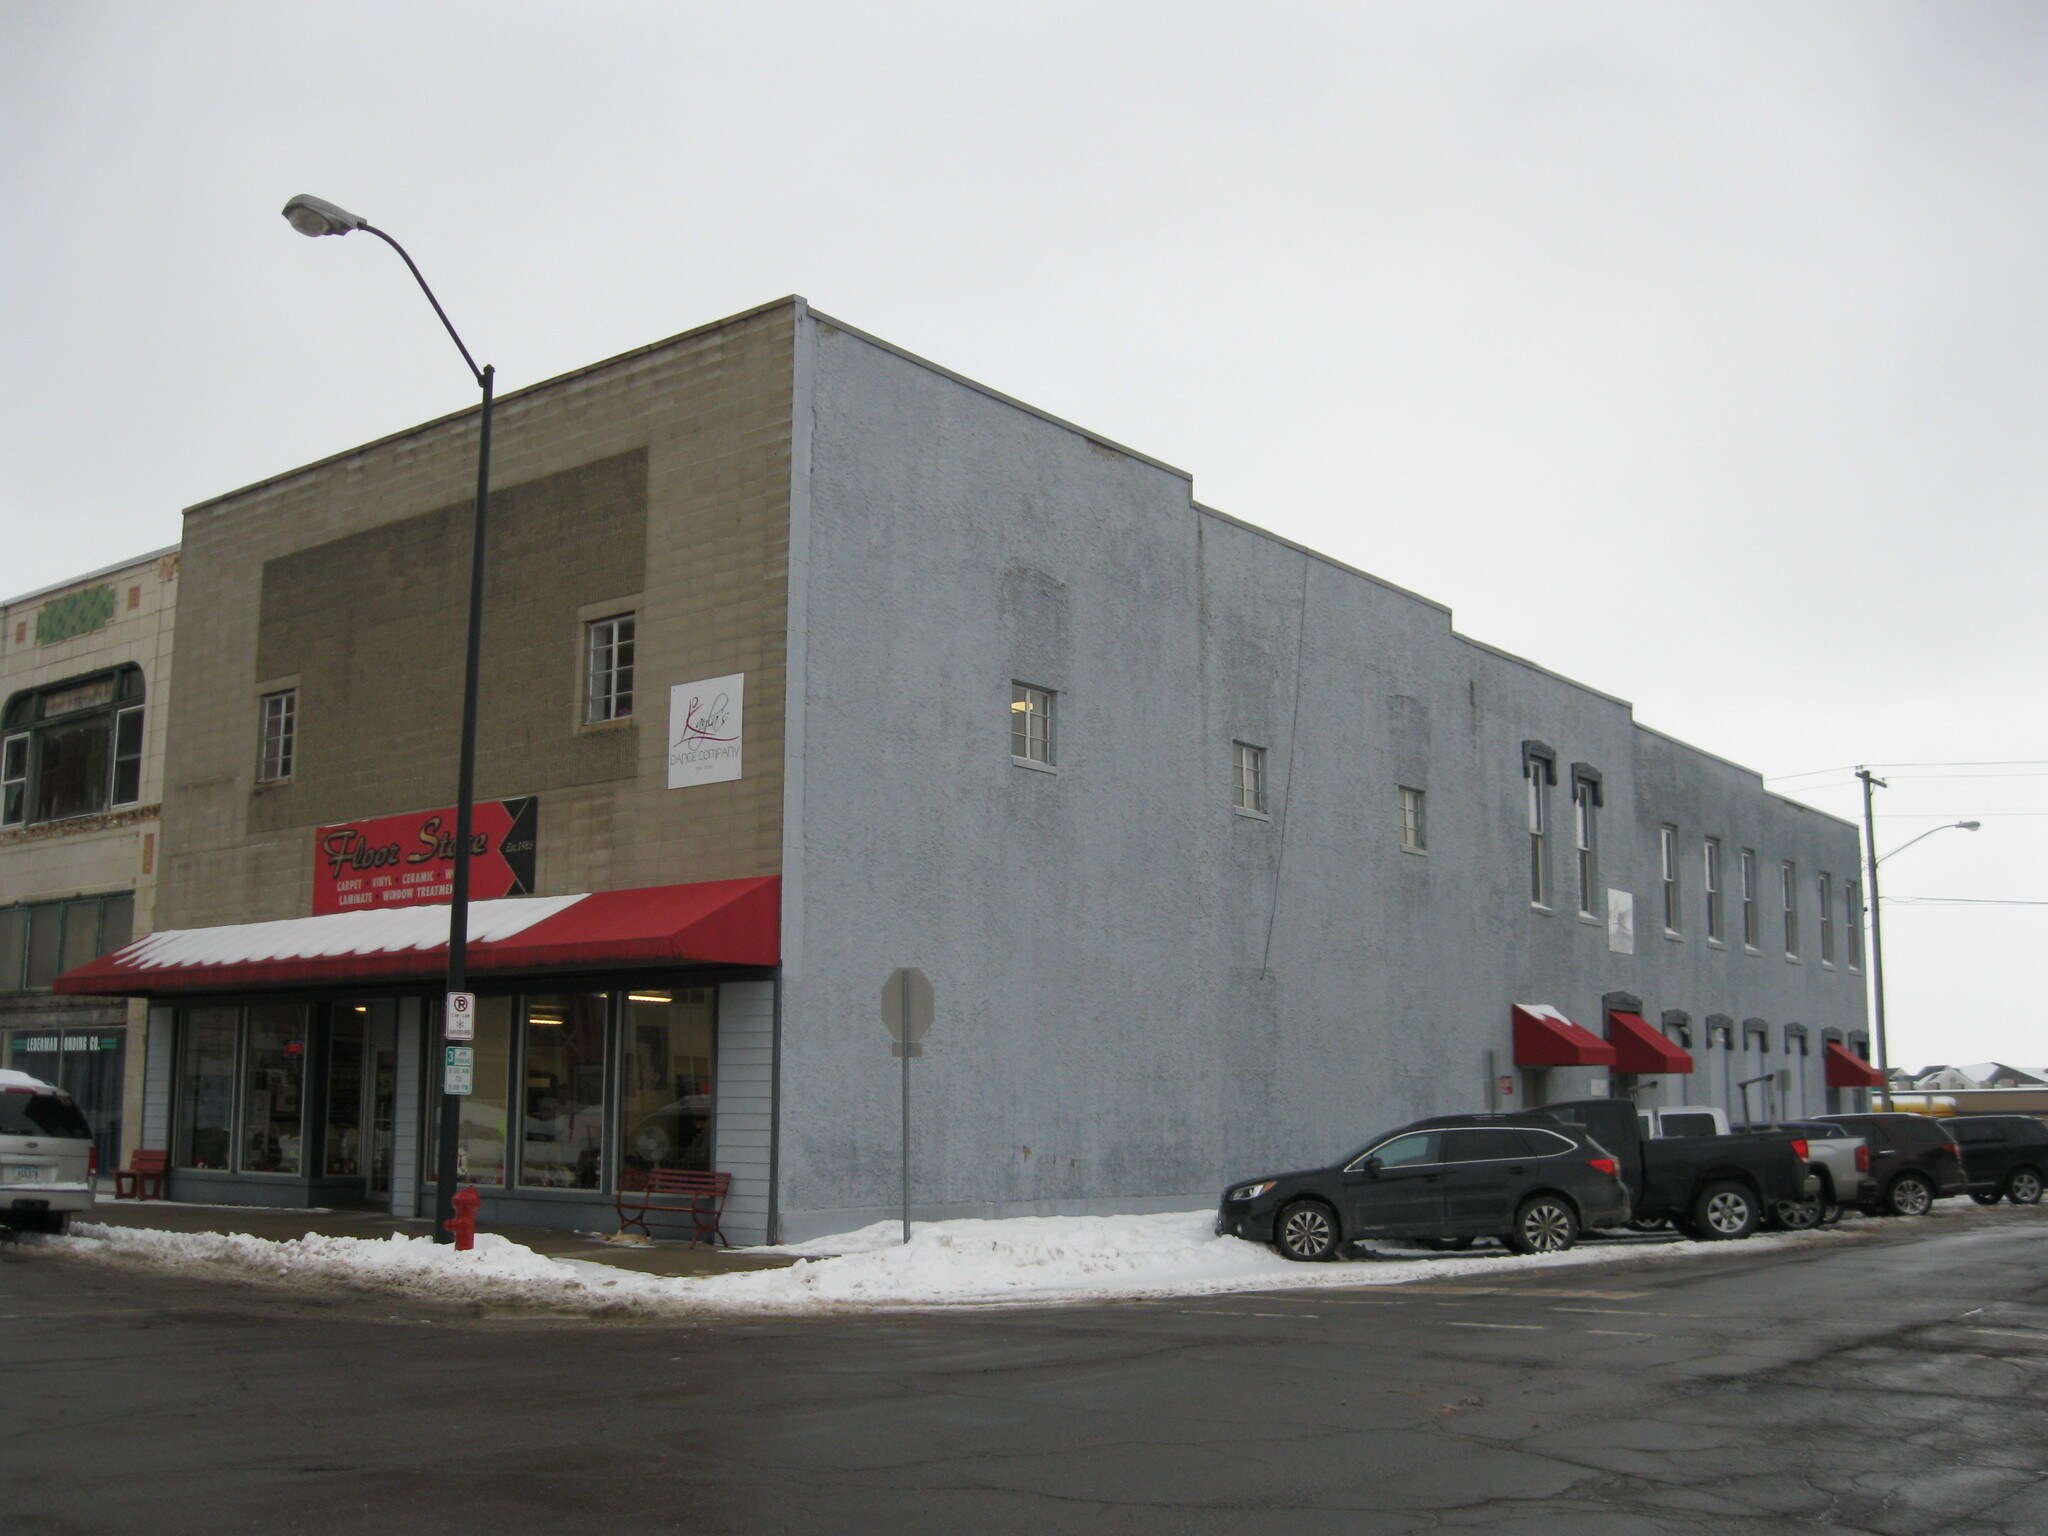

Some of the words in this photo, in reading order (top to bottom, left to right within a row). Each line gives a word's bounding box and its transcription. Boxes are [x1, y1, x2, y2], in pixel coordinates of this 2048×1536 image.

[670, 751, 697, 766] DANCE
[699, 744, 741, 762] COMPANY
[323, 829, 401, 880] Floor
[406, 816, 488, 865] Stoe
[337, 879, 362, 892] CARPET
[372, 875, 393, 888] VINYL
[402, 870, 434, 884] CERAMIC
[338, 892, 373, 906] LAMINATE
[383, 887, 414, 901] WINDOW
[26, 1037, 58, 1052] LEDERMAN
[448, 1051, 454, 1062] 3
